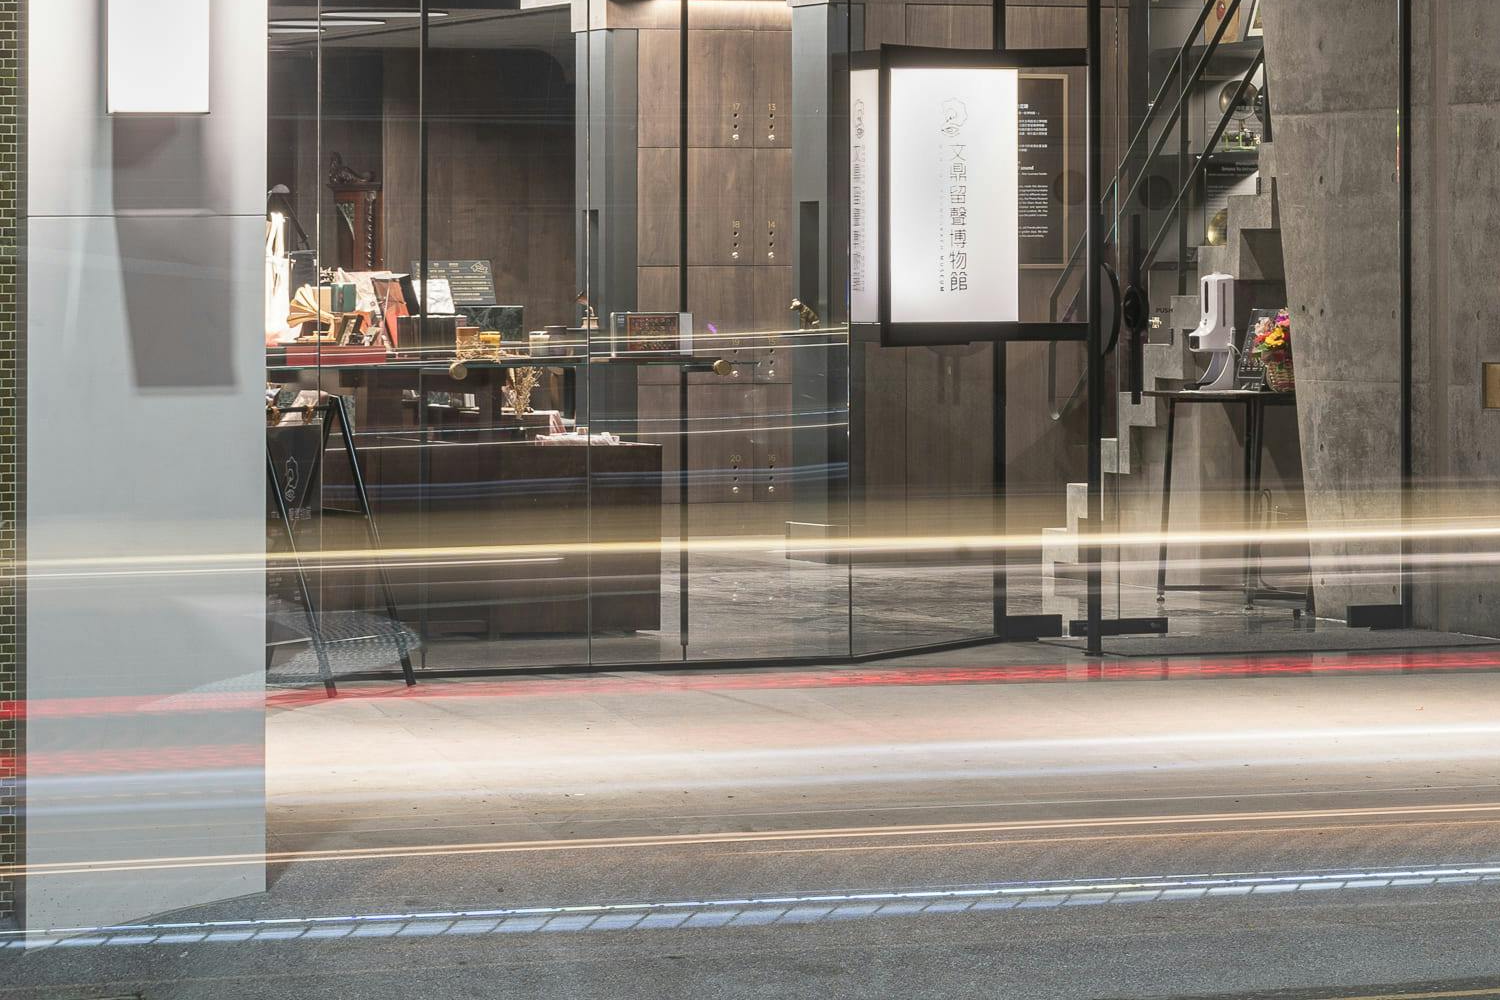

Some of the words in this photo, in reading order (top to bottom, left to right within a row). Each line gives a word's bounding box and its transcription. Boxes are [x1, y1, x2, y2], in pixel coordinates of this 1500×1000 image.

[732, 103, 741, 111] 17
[949, 143, 968, 292] 文鼎留聲博物館
